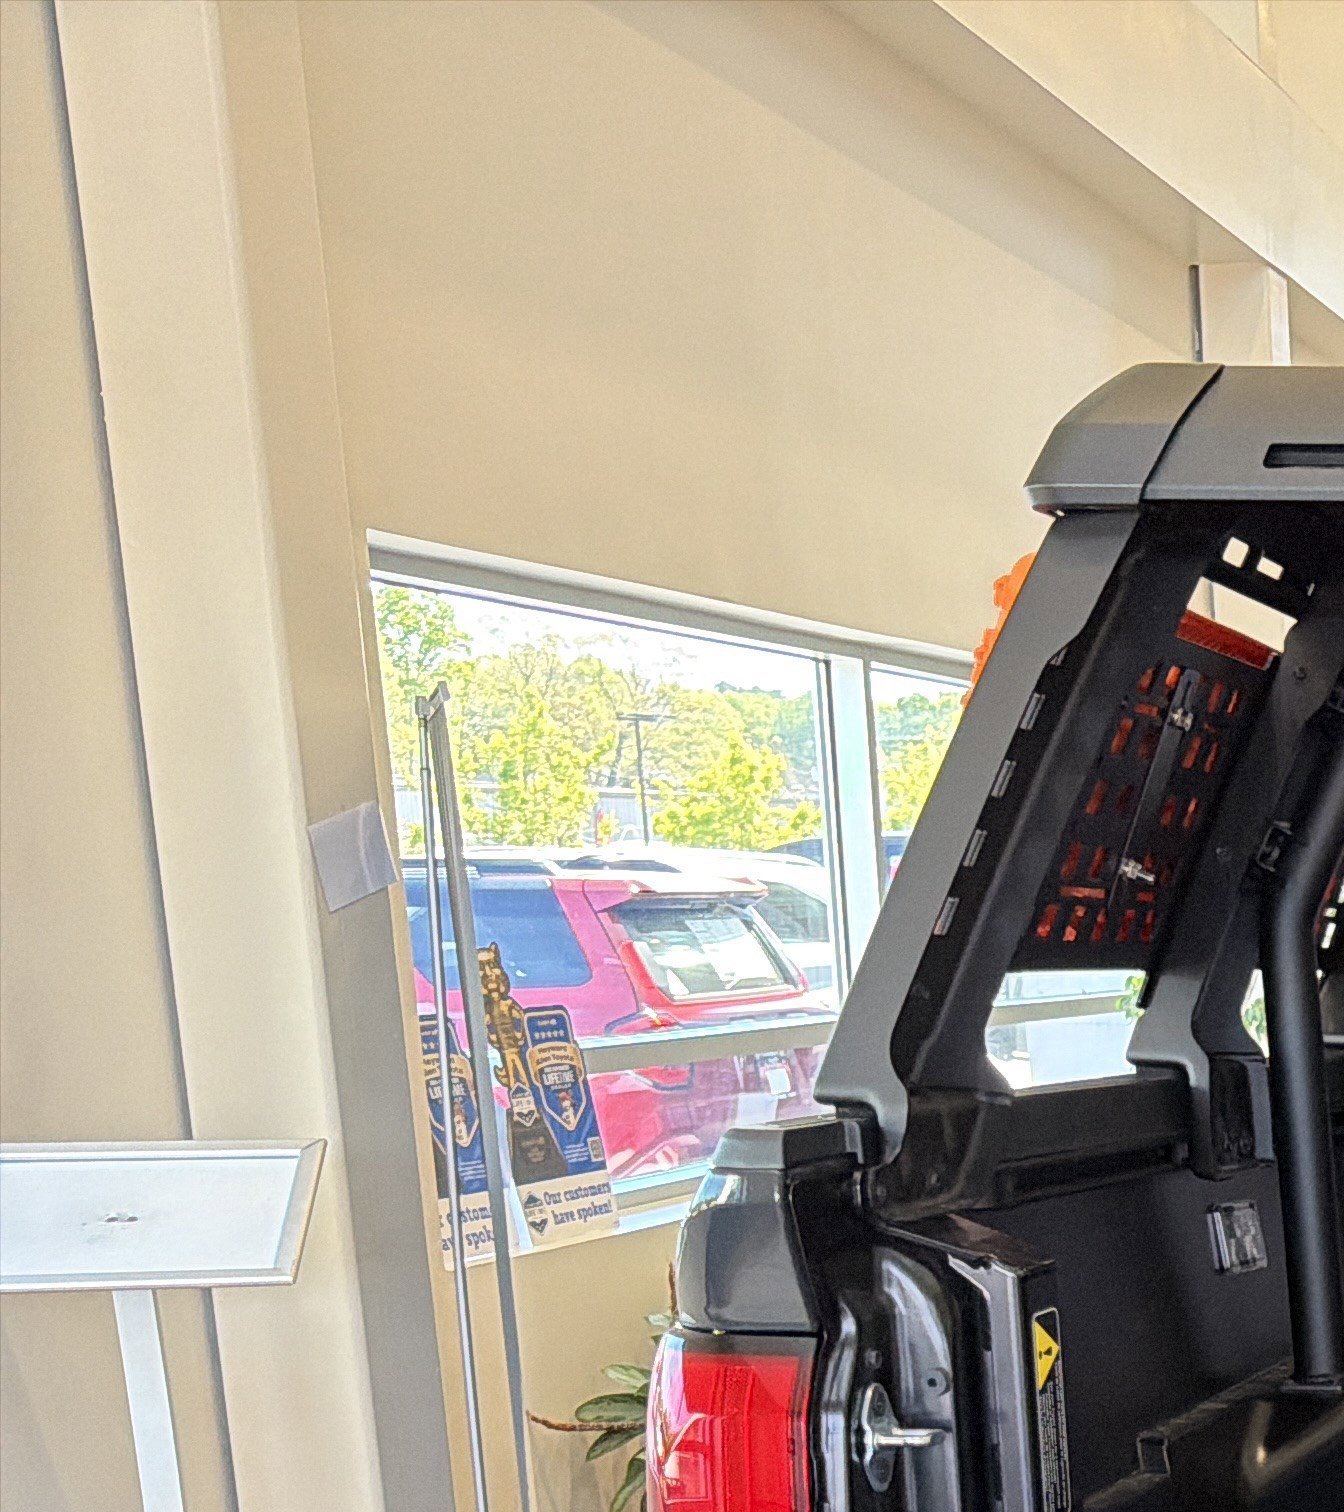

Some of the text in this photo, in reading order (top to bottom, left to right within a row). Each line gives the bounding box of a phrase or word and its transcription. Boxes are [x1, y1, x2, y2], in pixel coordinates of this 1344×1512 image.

[543, 1182, 612, 1206] Our customers
[551, 1208, 577, 1226] have
[577, 1198, 614, 1223] spoken!
